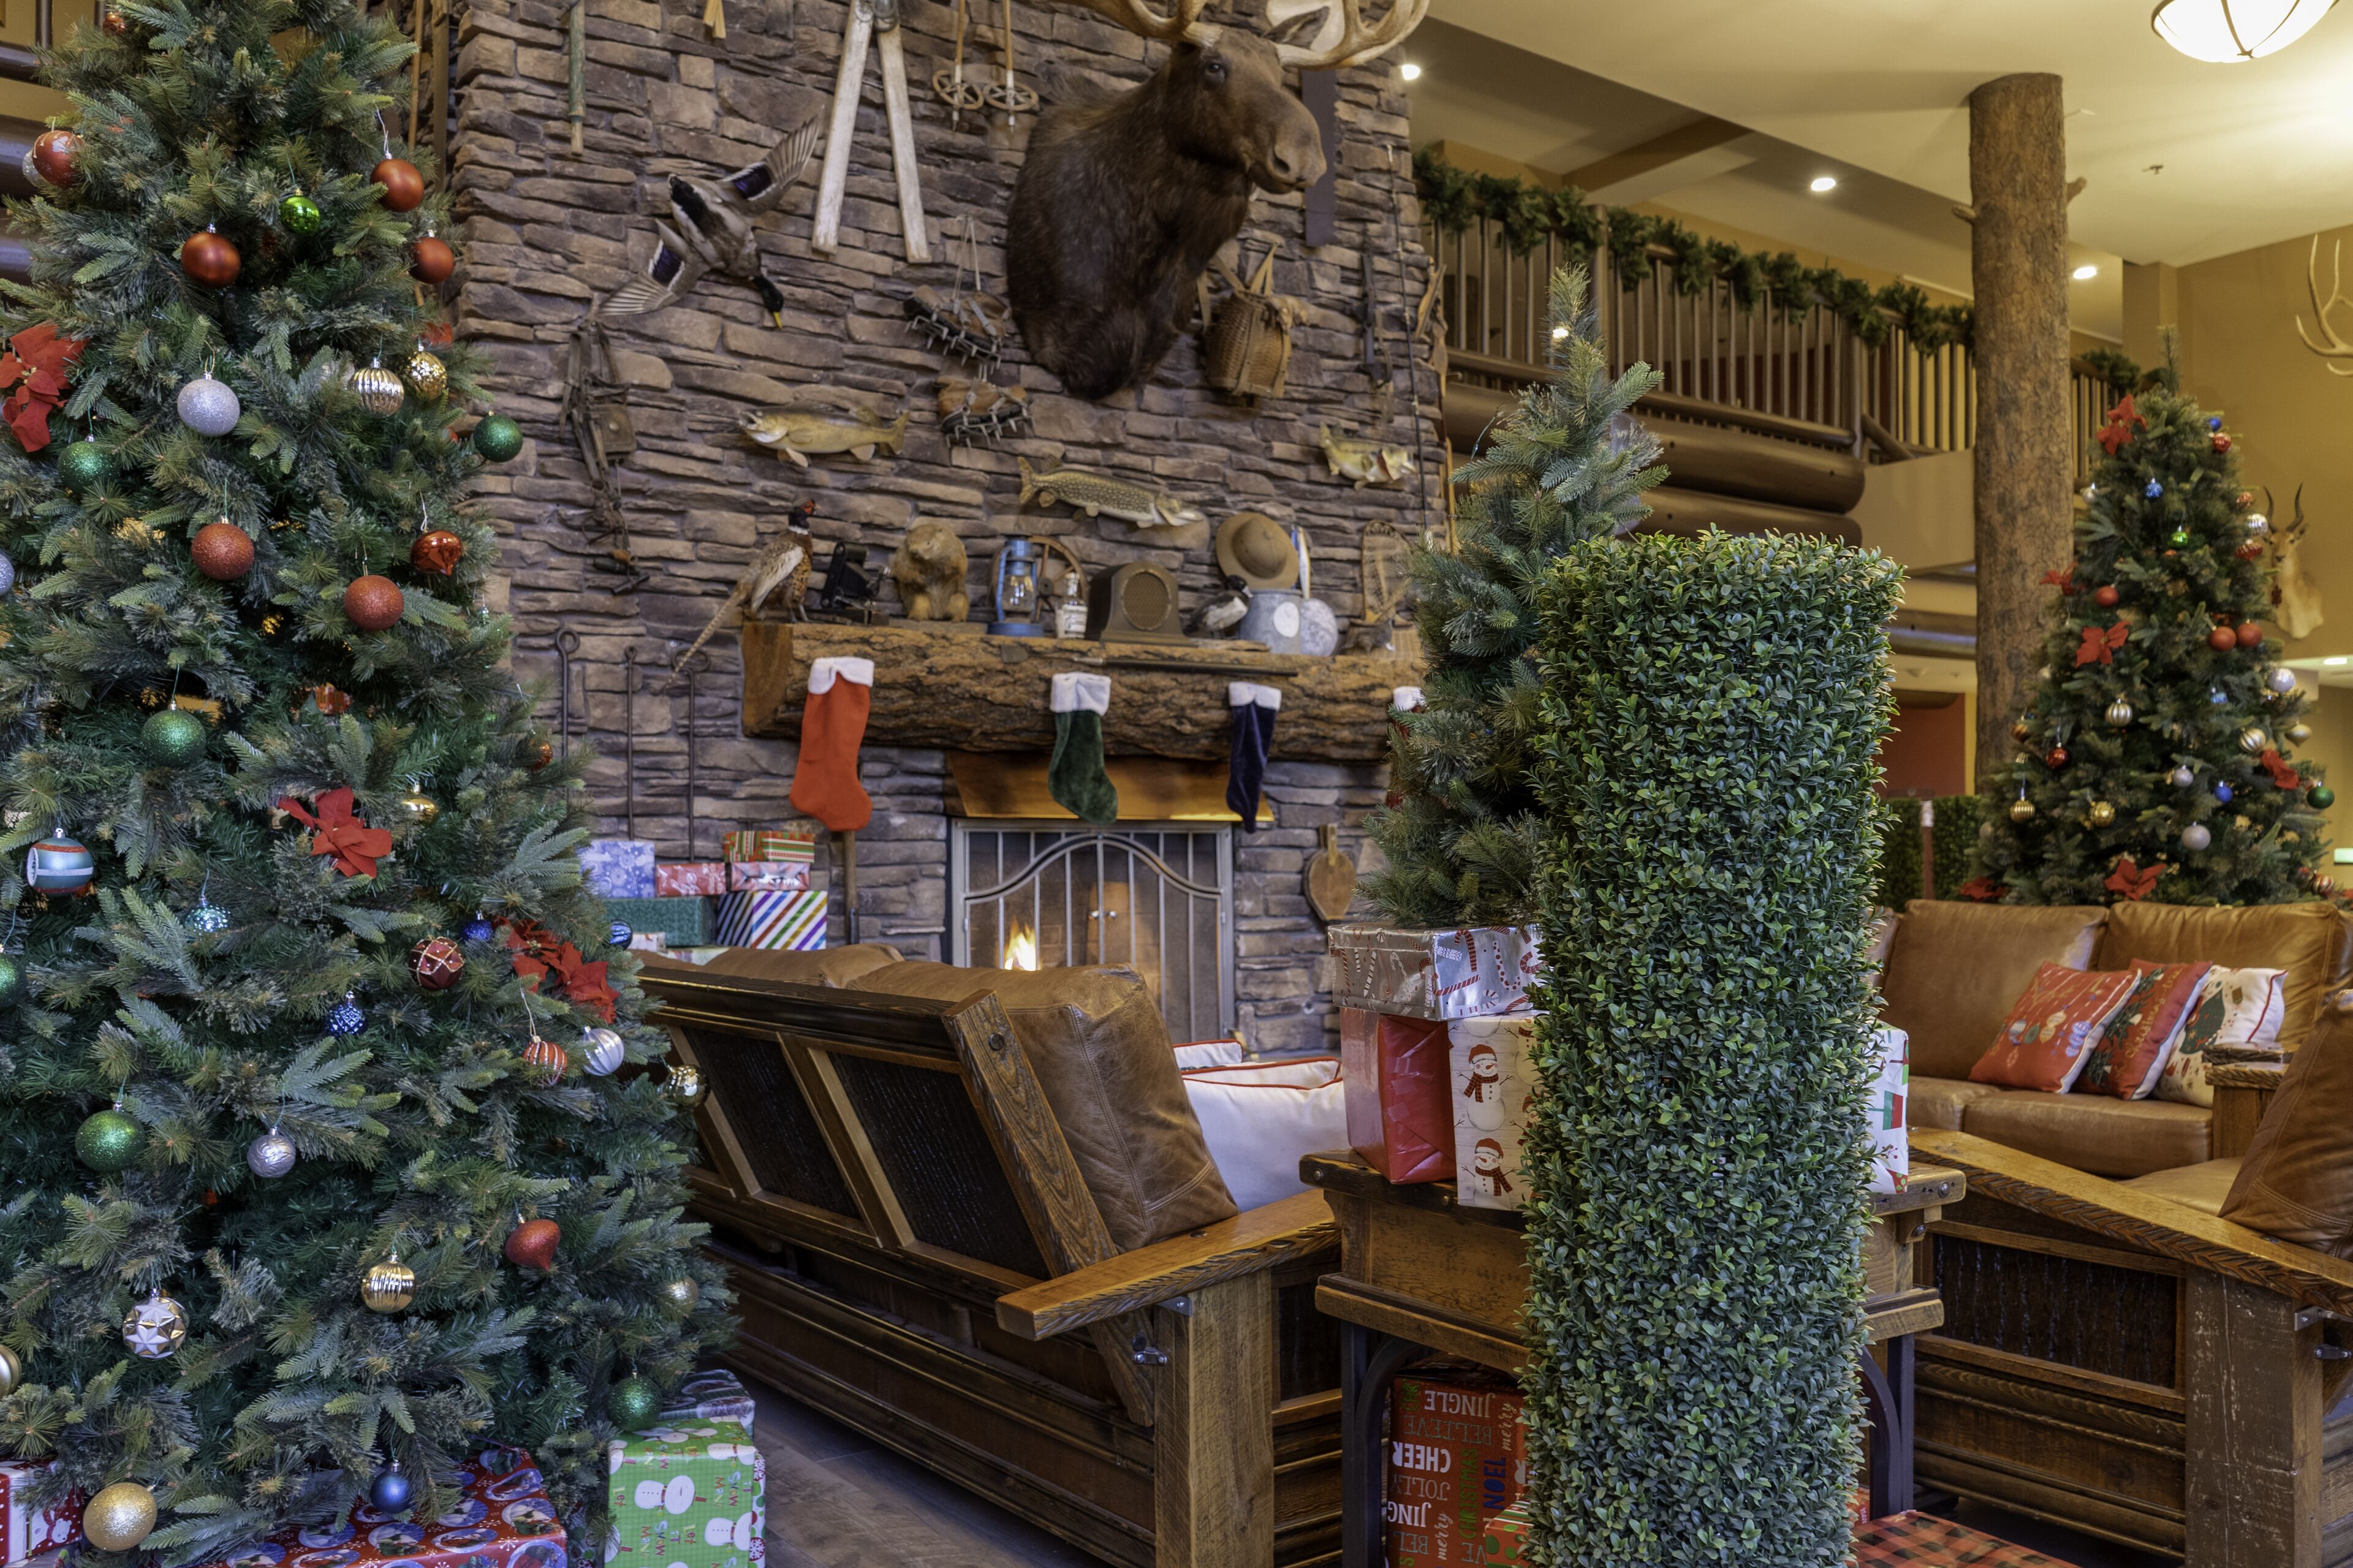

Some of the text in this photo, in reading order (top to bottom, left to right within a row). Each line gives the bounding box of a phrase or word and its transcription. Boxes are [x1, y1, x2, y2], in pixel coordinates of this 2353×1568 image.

[1425, 1390, 1496, 1418] JINGLE
[1403, 1414, 1493, 1446] BELIEVE
[1498, 1401, 1518, 1451] merry
[1392, 1441, 1452, 1474] CHEER
[613, 1486, 626, 1507] Let
[1390, 1473, 1450, 1501] JOLLY
[1458, 1448, 1478, 1539] CHRISTMAS
[1483, 1456, 1506, 1510] NOEL
[683, 1524, 697, 1545] Let
[1434, 1510, 1453, 1561] merry
